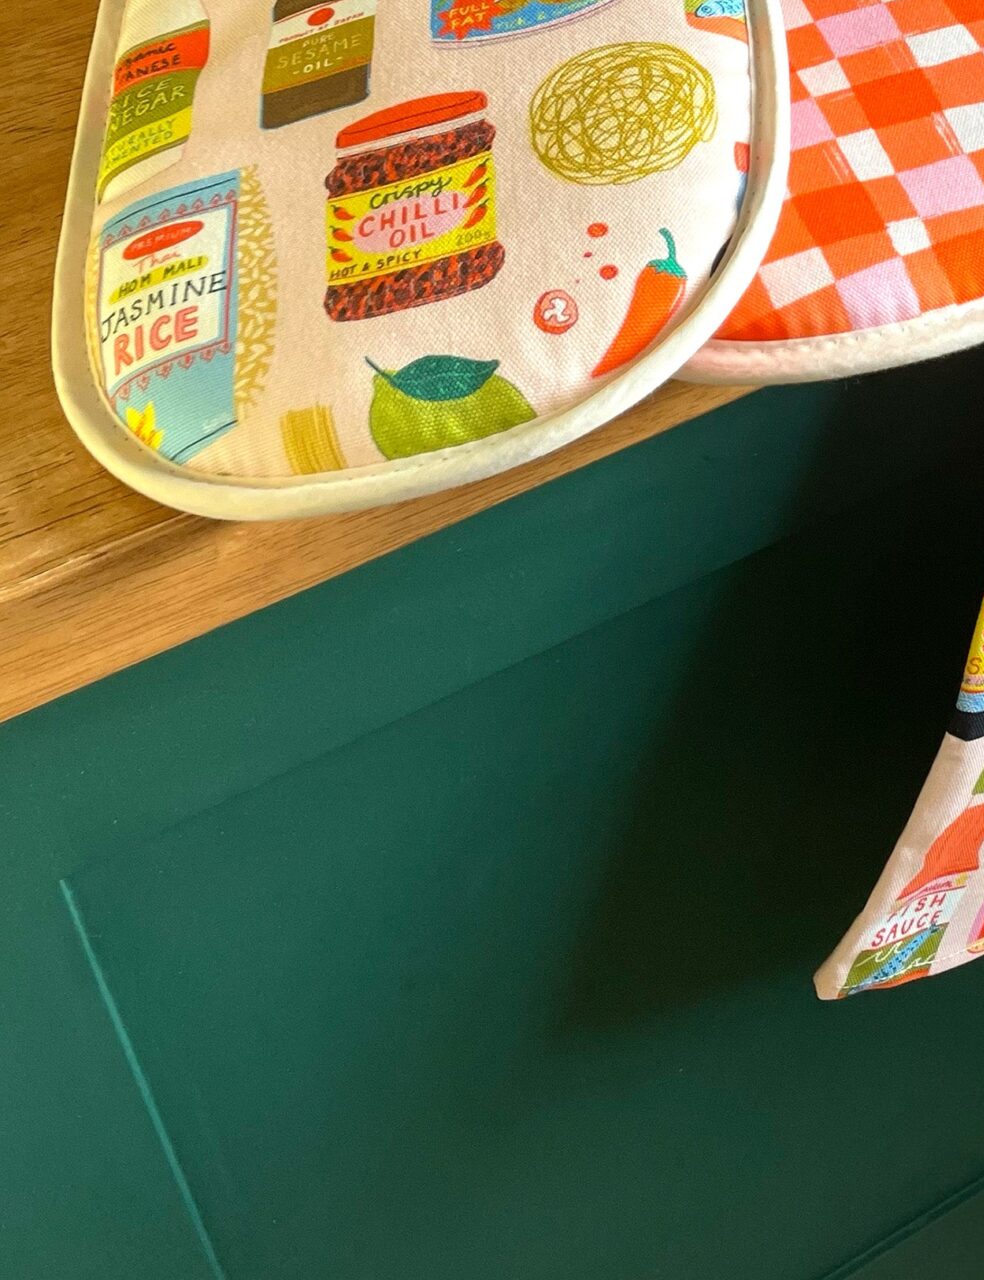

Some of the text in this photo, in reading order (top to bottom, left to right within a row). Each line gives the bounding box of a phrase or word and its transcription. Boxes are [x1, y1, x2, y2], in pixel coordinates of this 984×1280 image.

[449, 2, 490, 19] FULL
[450, 12, 486, 29] FAT
[277, 34, 363, 69] SESAME
[358, 192, 460, 238] CHILLI
[389, 222, 435, 248] OIL
[118, 255, 204, 300] HOM MALI
[330, 264, 356, 280] HOT
[376, 249, 423, 270] SPICY
[101, 270, 228, 343] JASMINE
[113, 304, 199, 376] RICE
[871, 910, 943, 947] SAUCE
